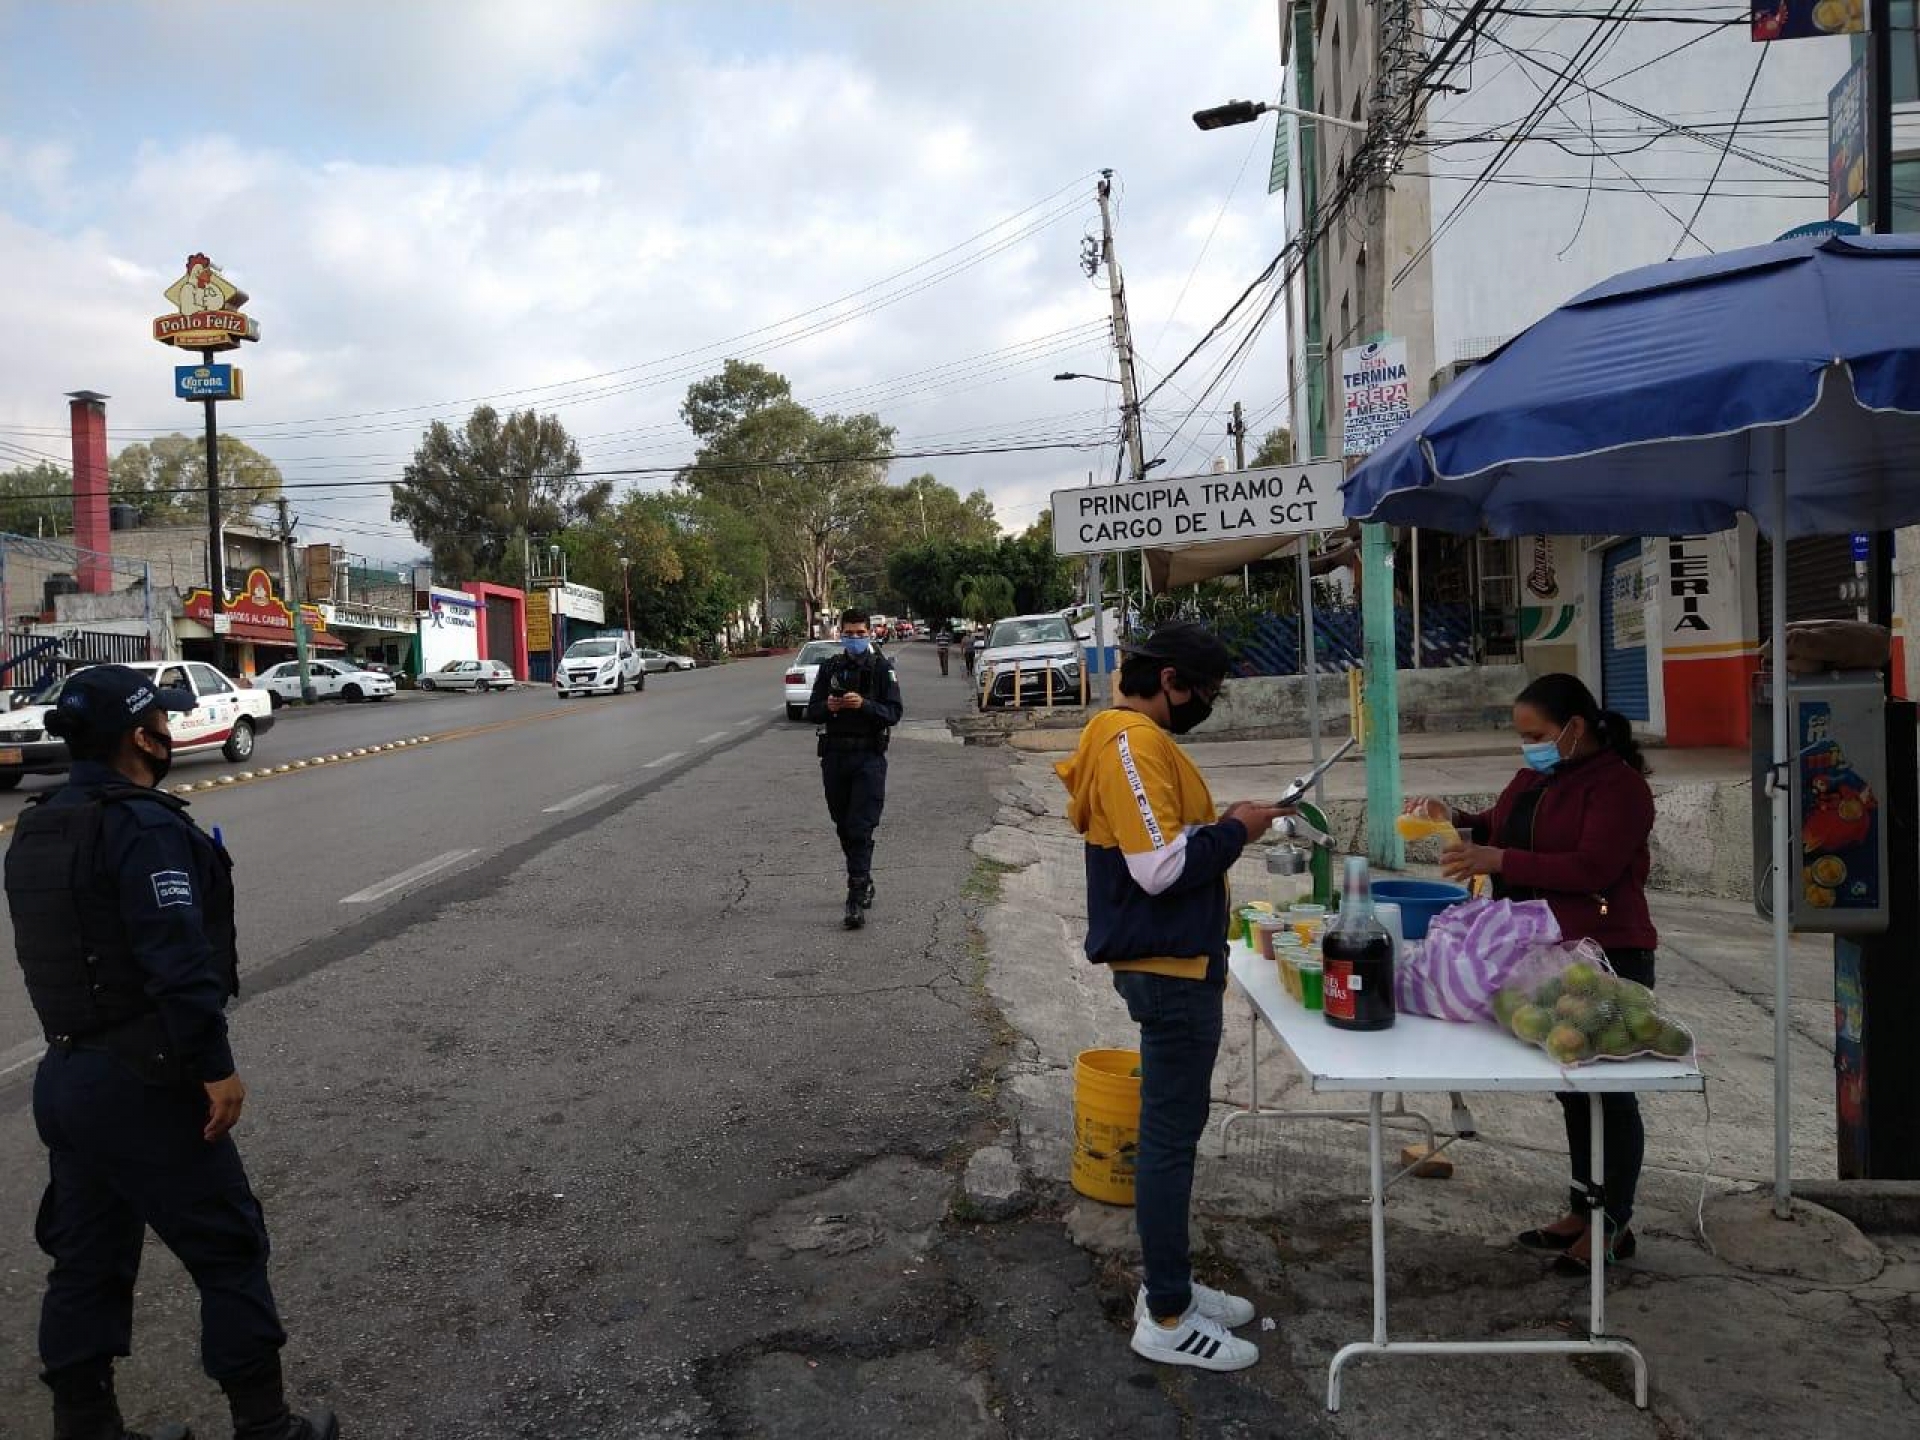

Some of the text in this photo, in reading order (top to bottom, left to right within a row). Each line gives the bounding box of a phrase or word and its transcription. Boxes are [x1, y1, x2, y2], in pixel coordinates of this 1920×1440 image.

[161, 313, 241, 334] Pollo Feliz
[181, 376, 223, 390] Corona
[1344, 364, 1406, 388] TERMINA
[1344, 385, 1406, 408] PREPA
[1356, 398, 1408, 416] MESES
[1080, 474, 1314, 516] PRINCIPIA TRAMO A
[1079, 500, 1318, 544] CARGO DE LA SCT
[1143, 811, 1164, 850] TOMMY
